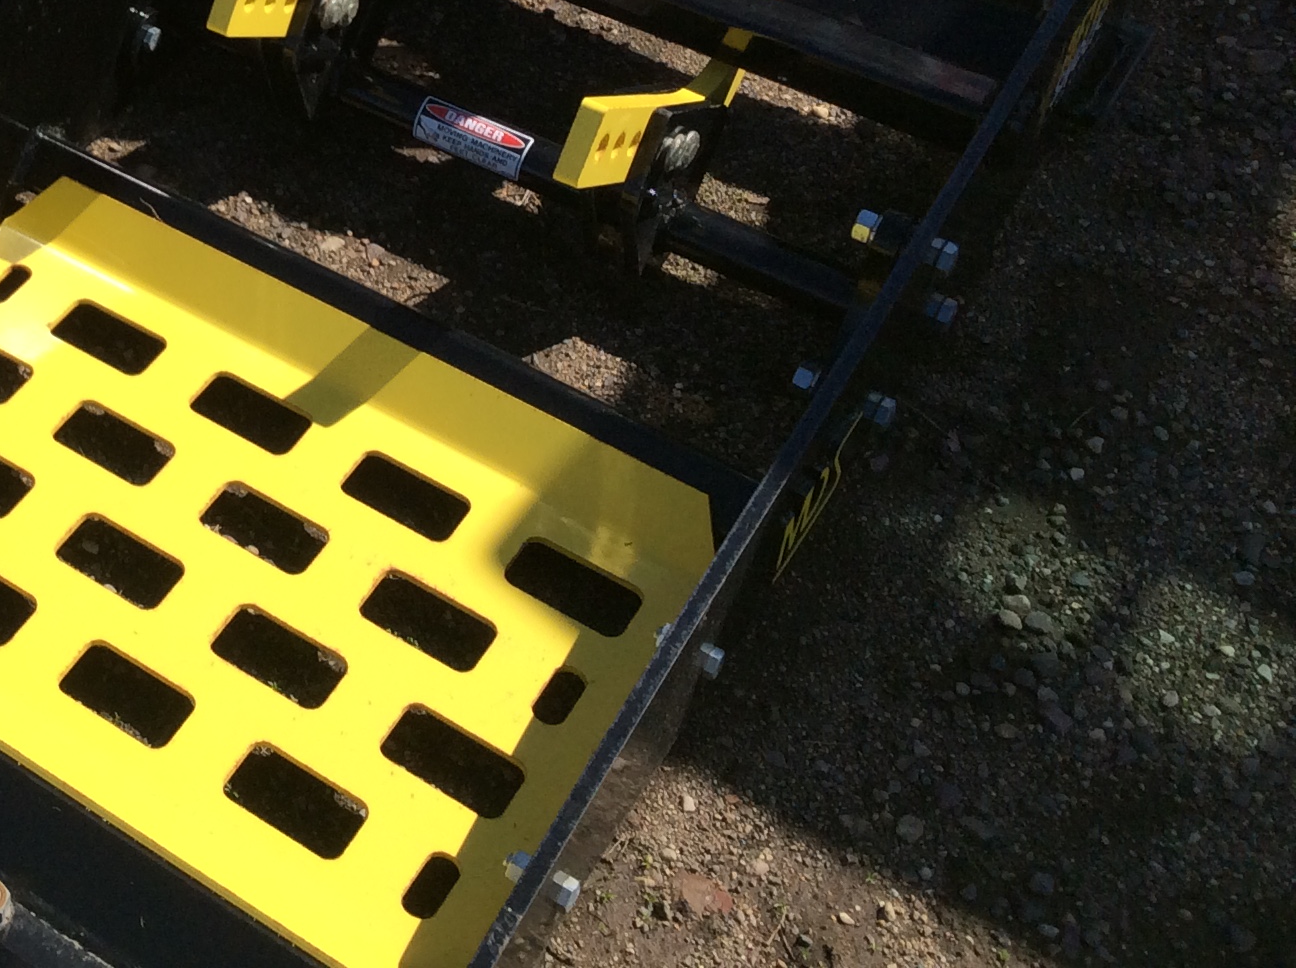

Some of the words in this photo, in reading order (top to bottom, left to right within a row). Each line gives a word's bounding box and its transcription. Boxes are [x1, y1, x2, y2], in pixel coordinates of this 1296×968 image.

[437, 123, 470, 142] MOVING
[470, 137, 518, 163] MACHINERY
[444, 108, 507, 143] DANGER
[442, 134, 463, 147] KEEP
[463, 143, 491, 159] HANDS
[491, 155, 509, 167] AND
